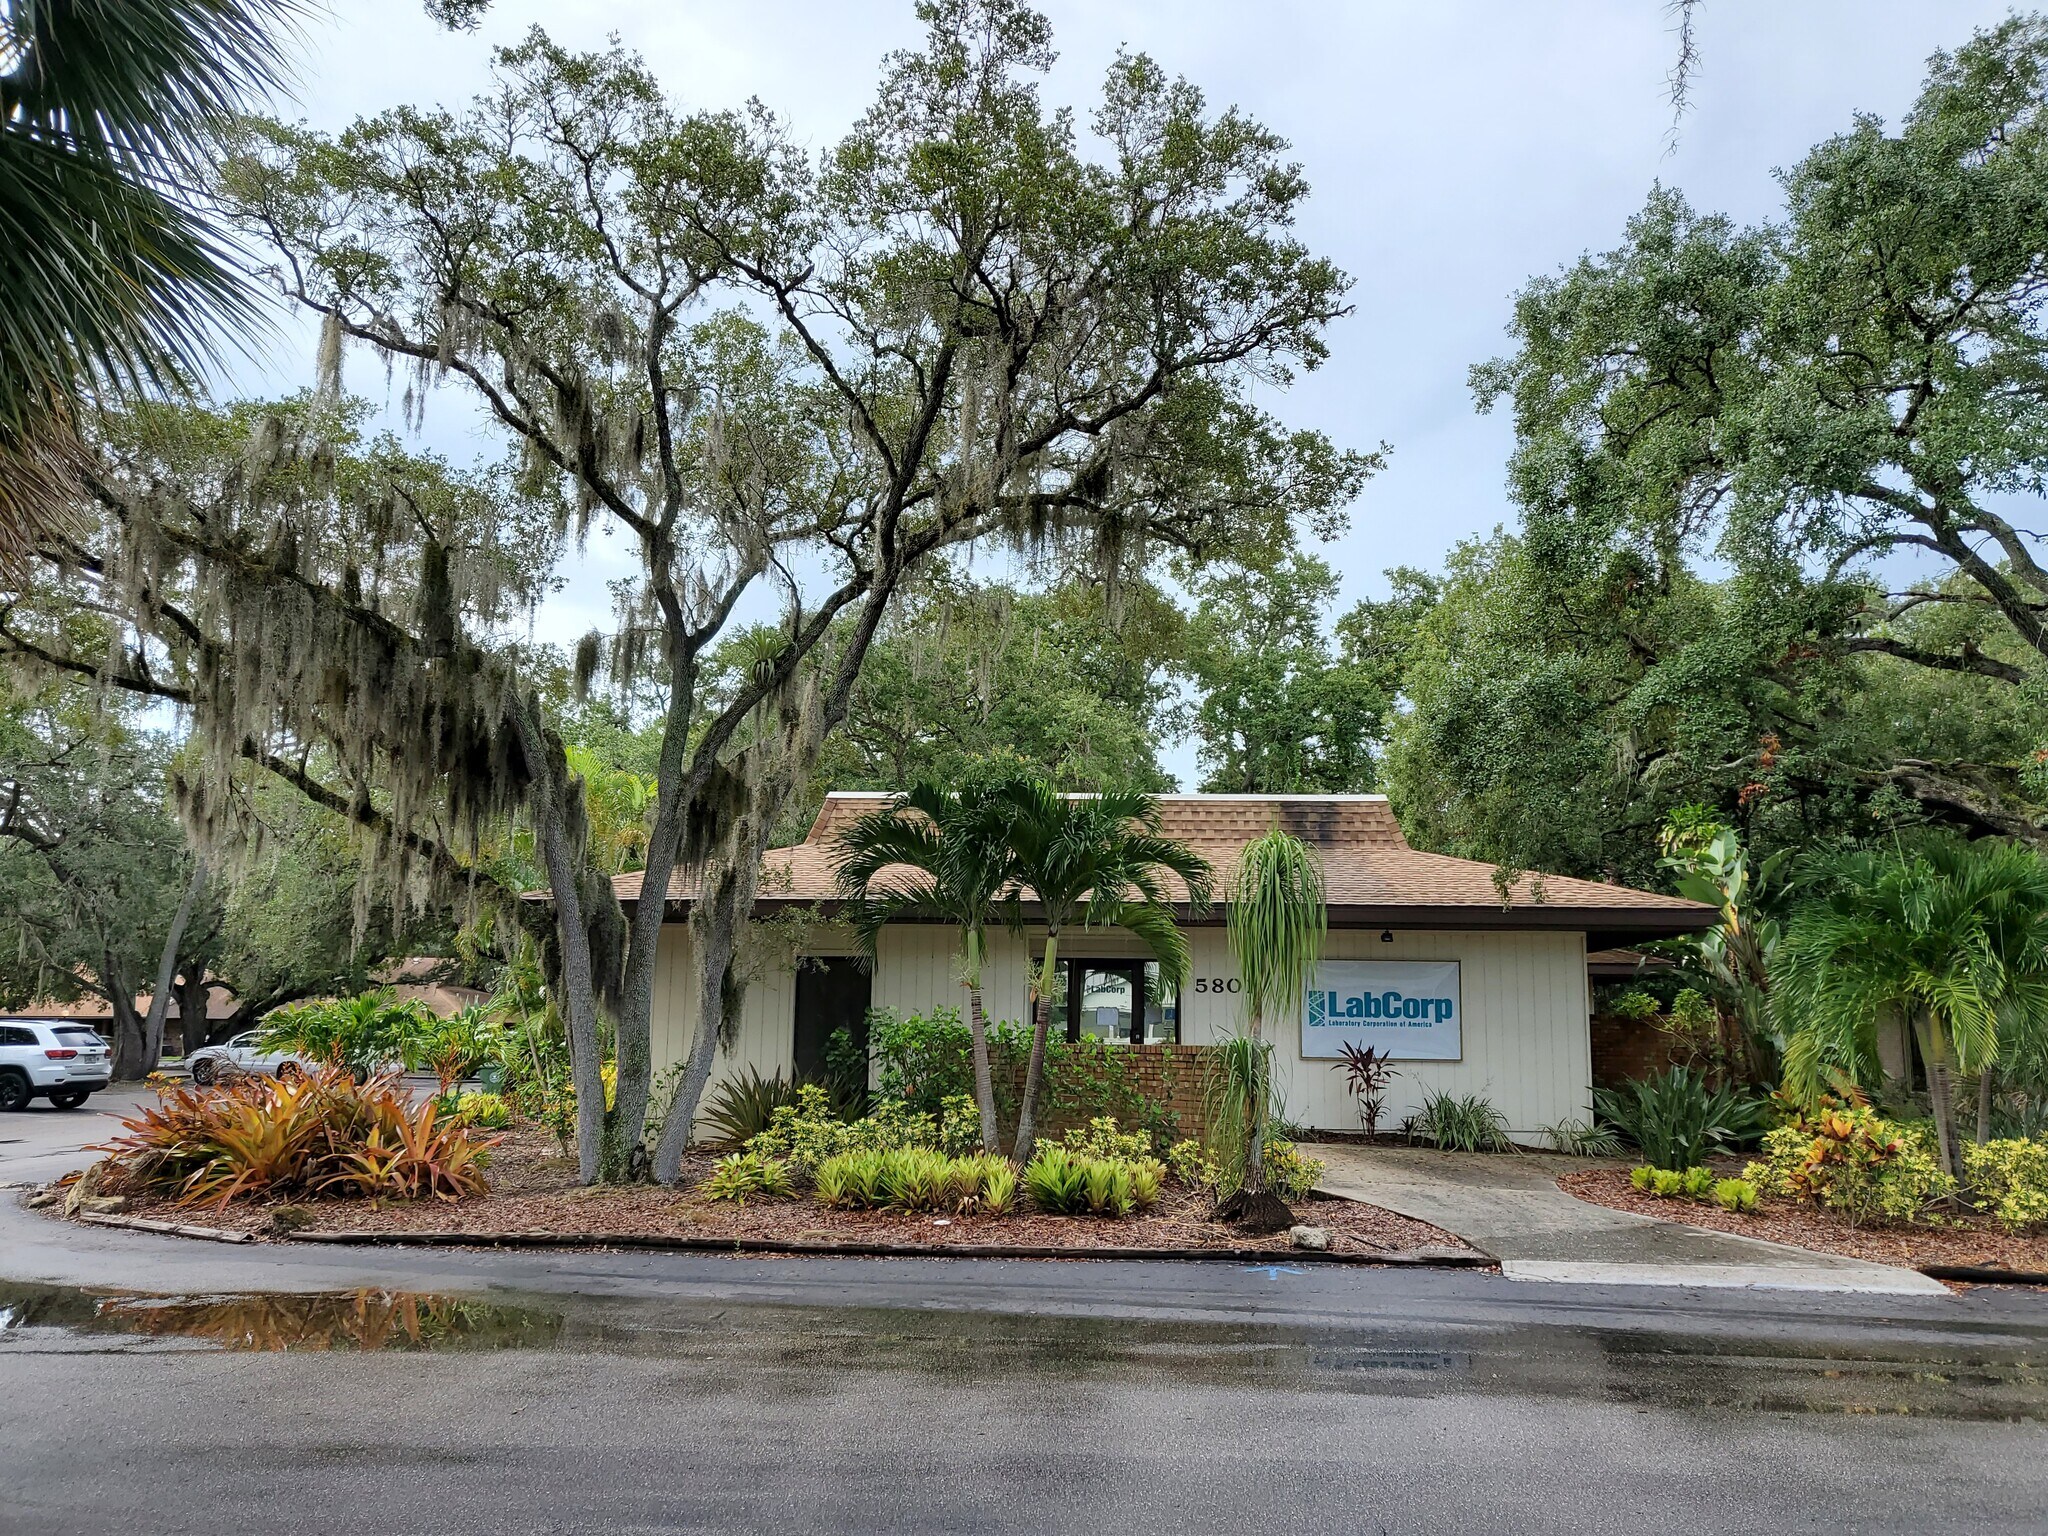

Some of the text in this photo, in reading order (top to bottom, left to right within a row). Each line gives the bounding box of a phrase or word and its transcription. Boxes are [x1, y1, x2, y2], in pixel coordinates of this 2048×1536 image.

[1091, 985, 1126, 995] LabCorp
[1328, 991, 1453, 1024] LabCorp
[1328, 1020, 1361, 1028] Laboratory
[1362, 1020, 1398, 1028] Corporation
[1408, 1020, 1432, 1028] America
